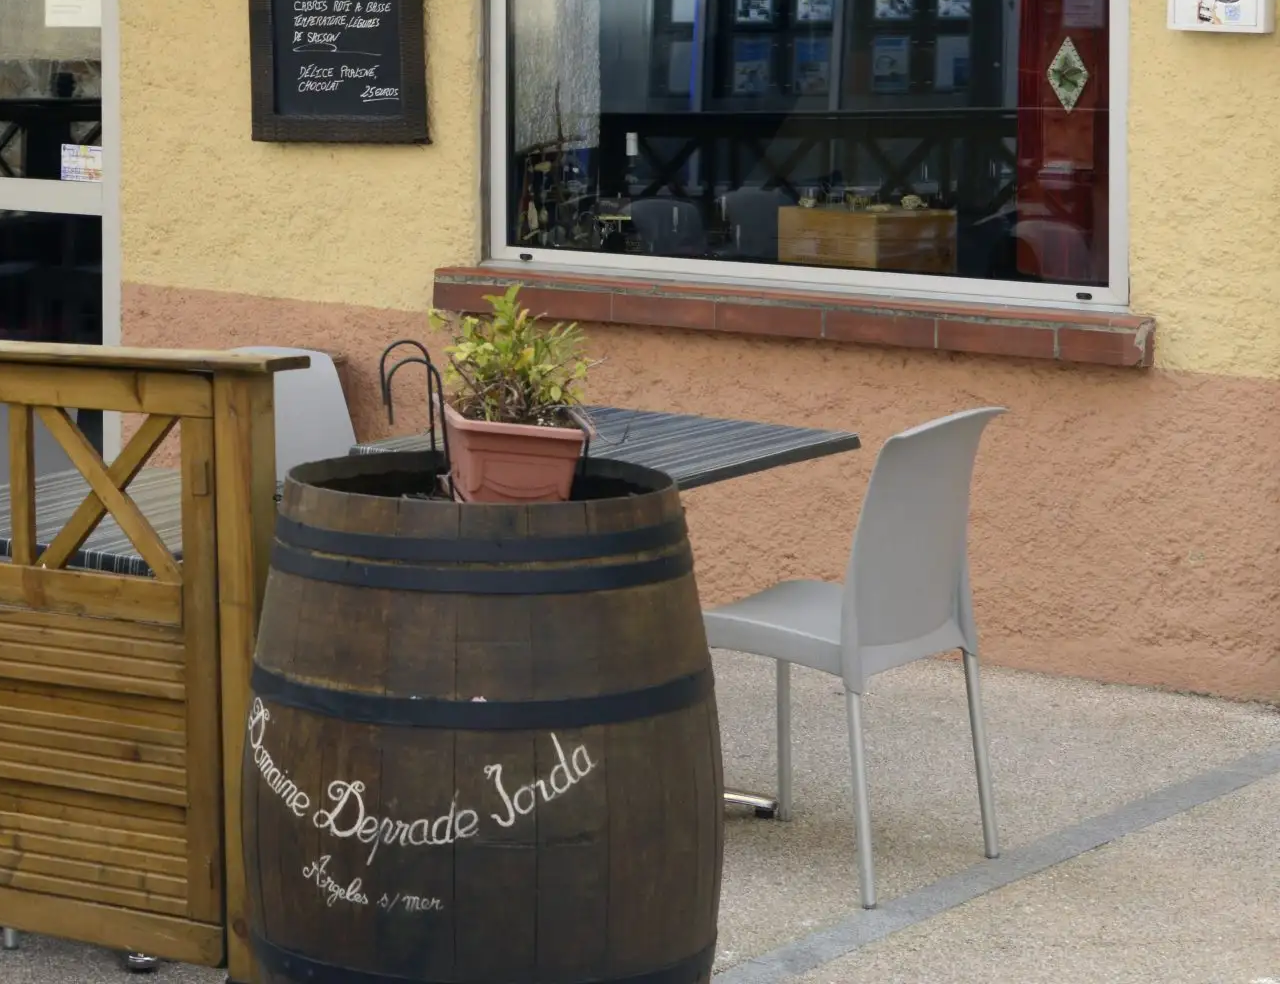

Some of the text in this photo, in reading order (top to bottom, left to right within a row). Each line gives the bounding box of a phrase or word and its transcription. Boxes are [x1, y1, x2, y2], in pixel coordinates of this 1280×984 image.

[293, 0, 328, 12] CABRIS
[365, 1, 392, 13] BASSE
[292, 31, 341, 44] DE SAISON
[297, 64, 334, 80] DÉLICE
[298, 80, 344, 92] CHOCOLAT
[248, 697, 596, 866] Domaine Deprade Jorda
[302, 855, 369, 907] Argeles
